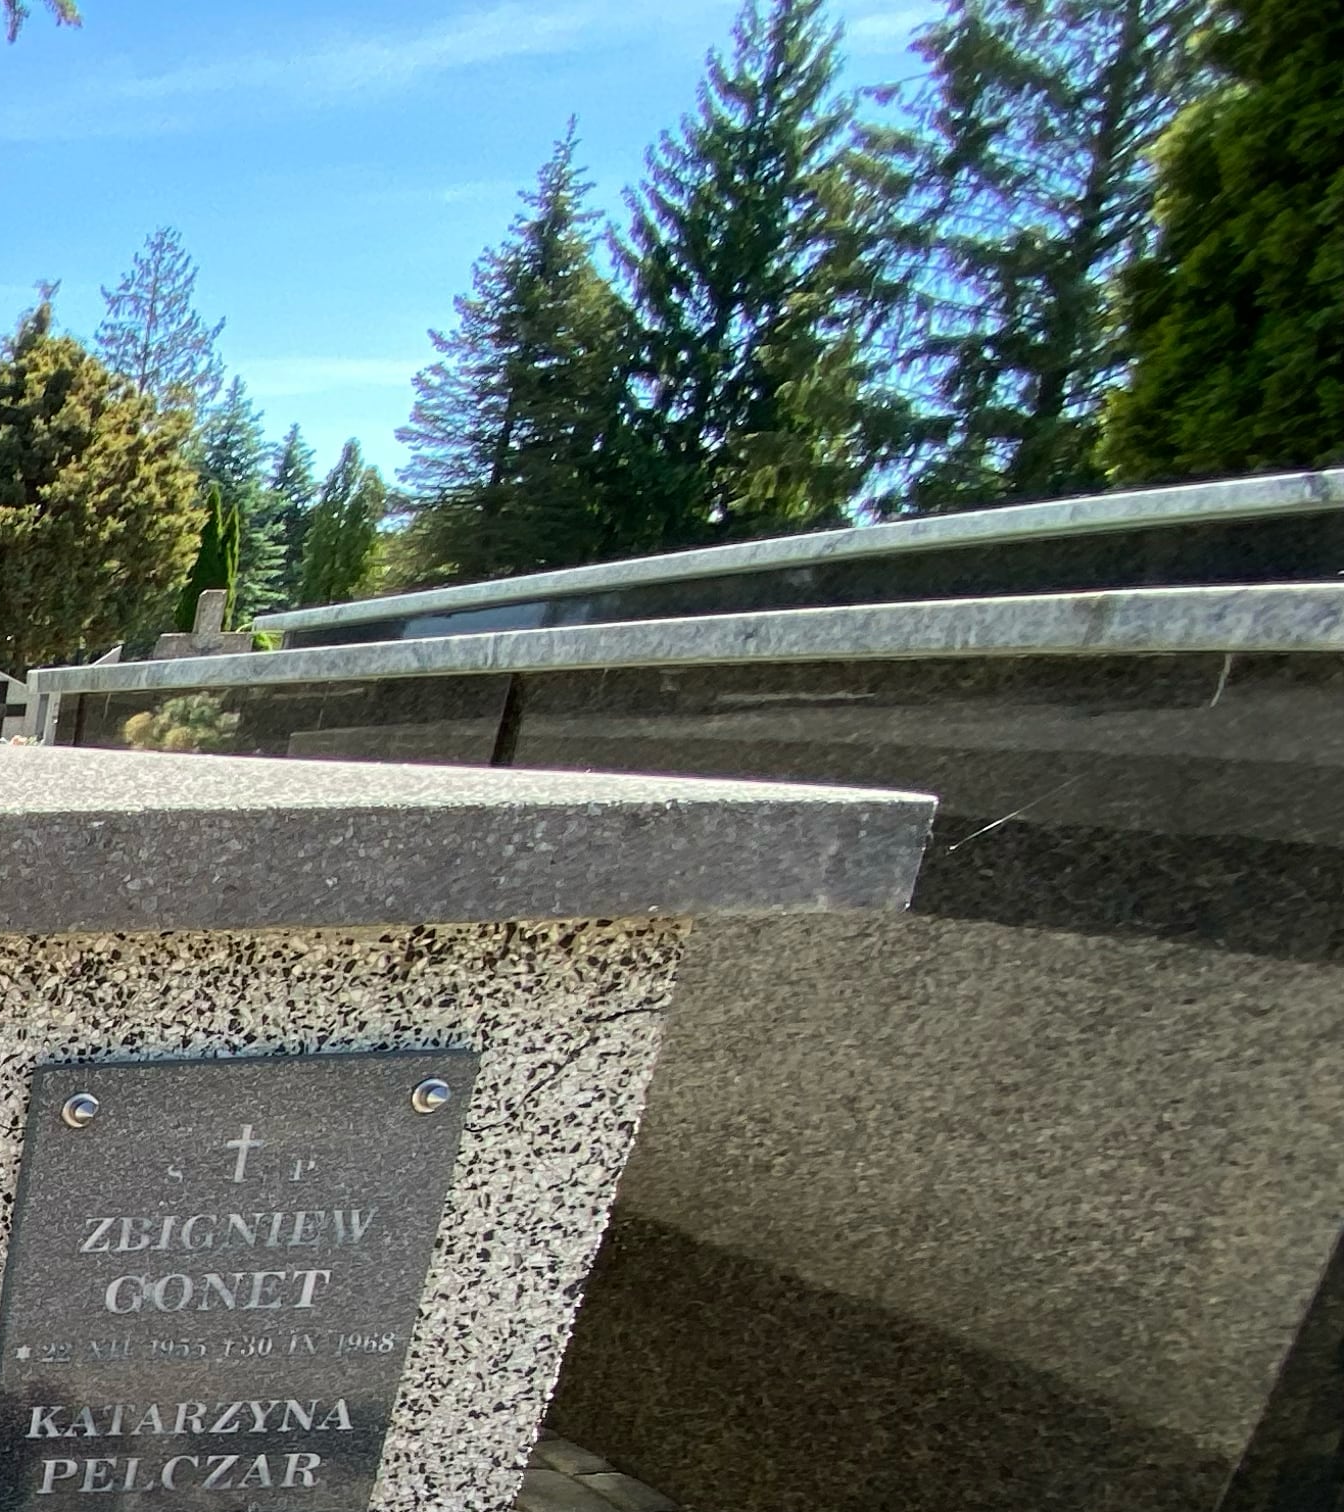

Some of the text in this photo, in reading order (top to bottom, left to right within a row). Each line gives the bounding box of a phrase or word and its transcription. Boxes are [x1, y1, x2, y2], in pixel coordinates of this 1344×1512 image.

[79, 1206, 379, 1253] ZBIGNIEW
[104, 1268, 333, 1315] GONET
[334, 1331, 397, 1359] 1968
[24, 1398, 355, 1439] KATARZYNA
[35, 1452, 323, 1495] PELCZAR
